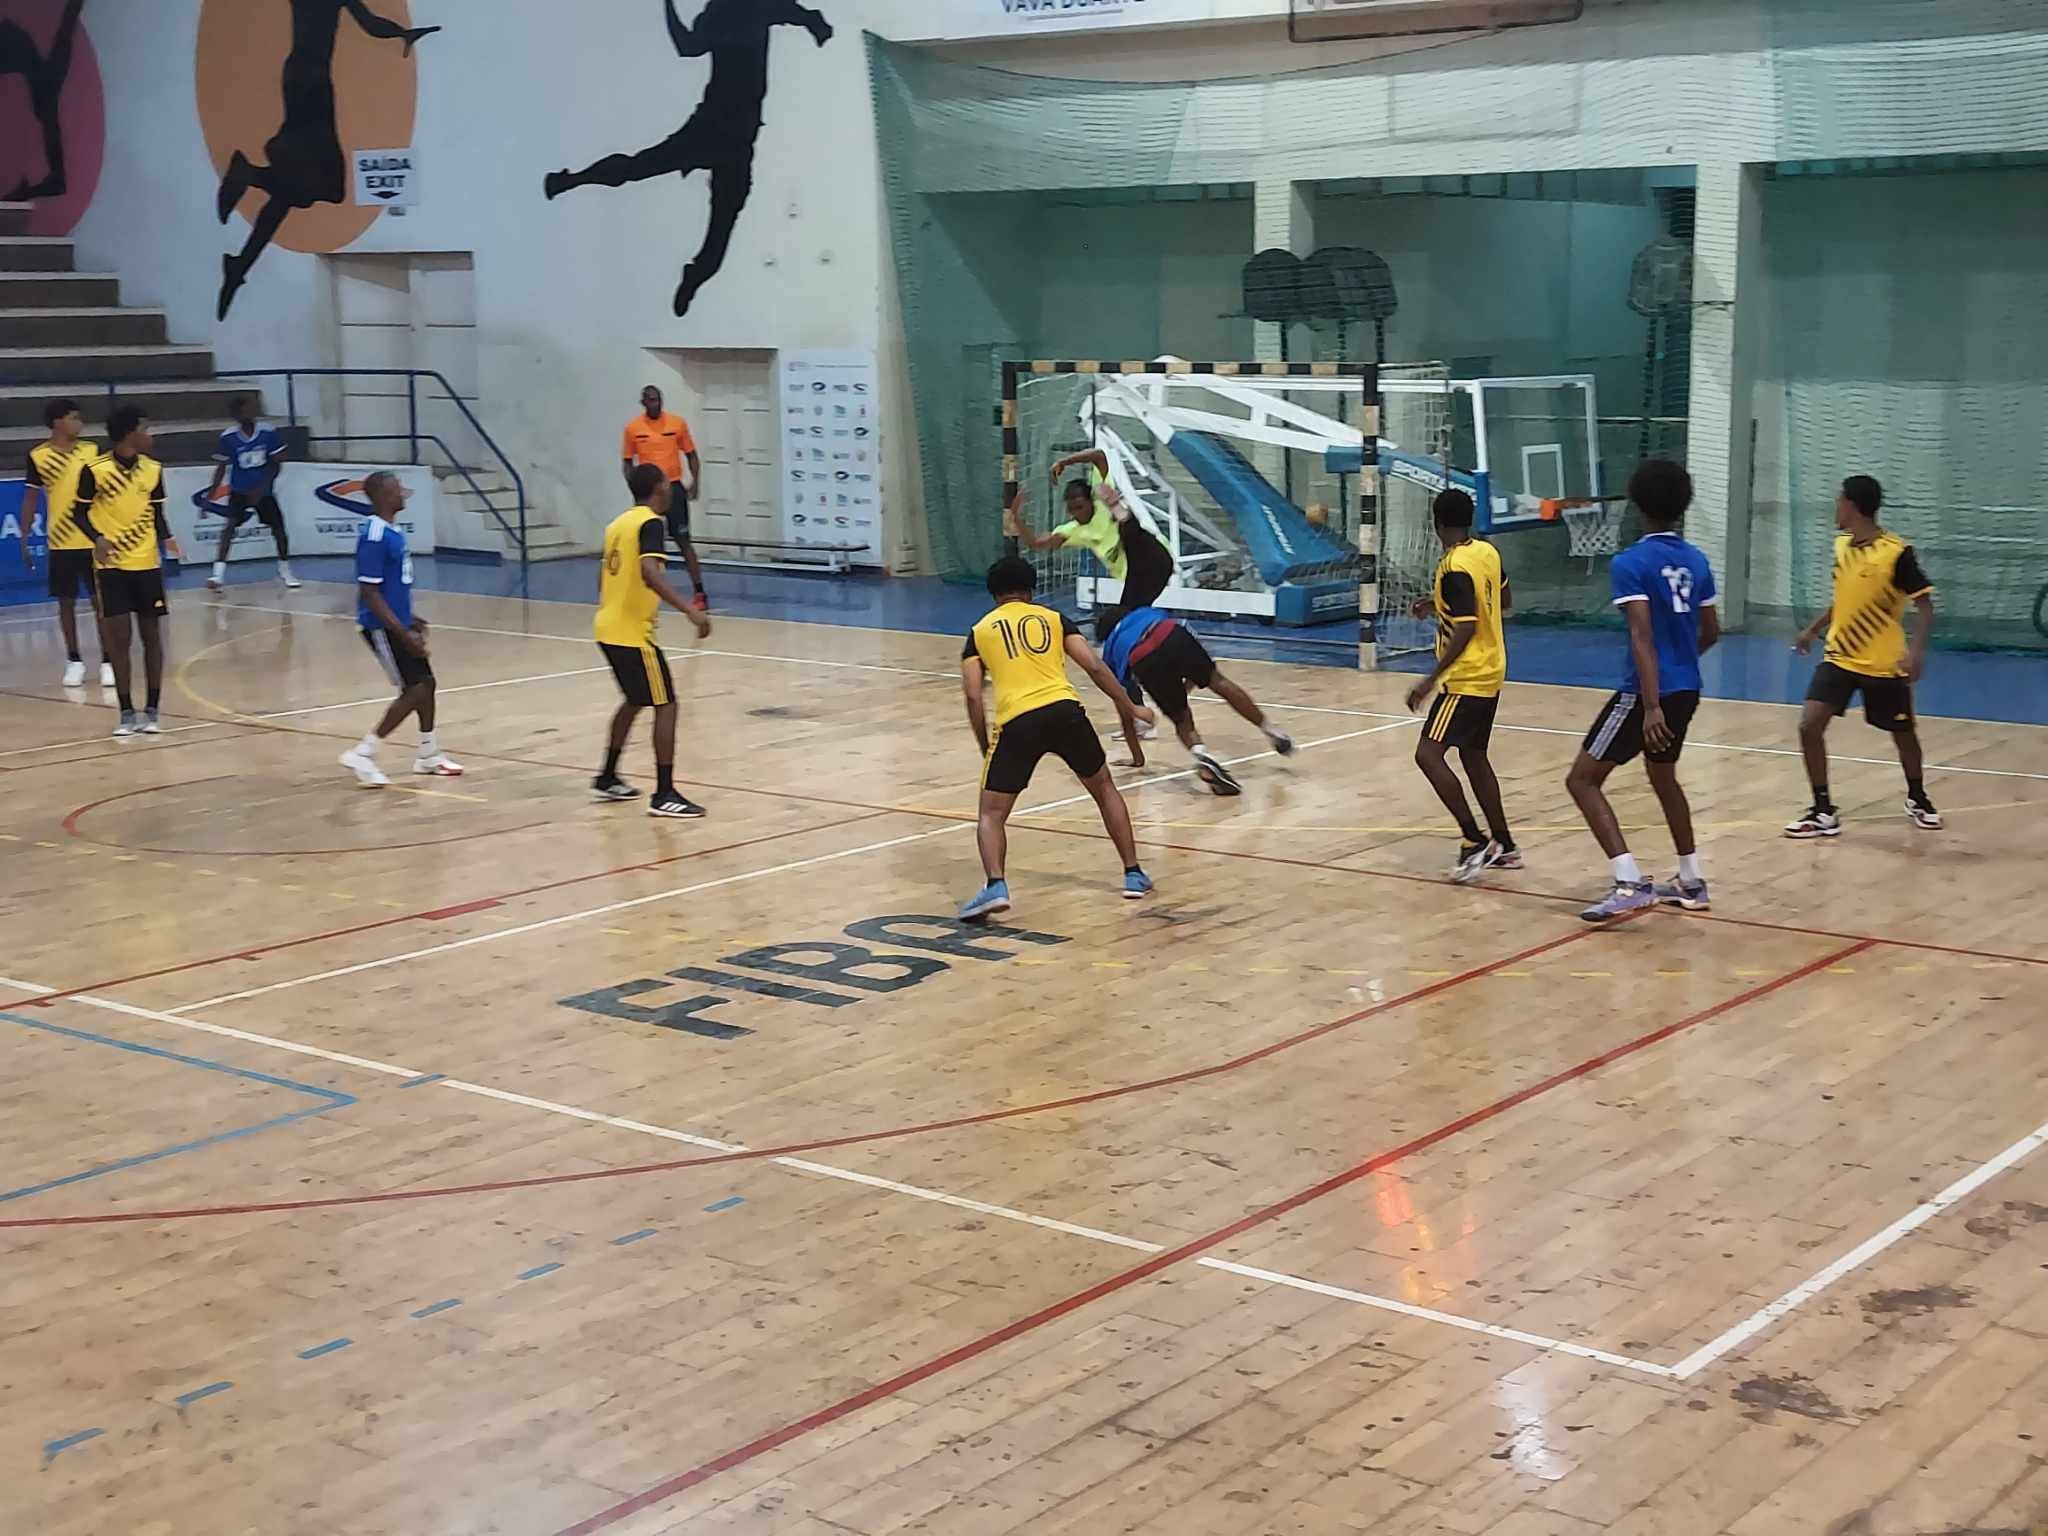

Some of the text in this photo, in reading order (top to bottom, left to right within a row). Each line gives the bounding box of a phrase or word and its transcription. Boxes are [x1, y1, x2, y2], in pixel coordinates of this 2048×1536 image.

[365, 175, 406, 188] EXIT
[315, 523, 355, 533] VAVA
[991, 614, 1051, 660] 10
[557, 913, 1074, 1039] FIBA
